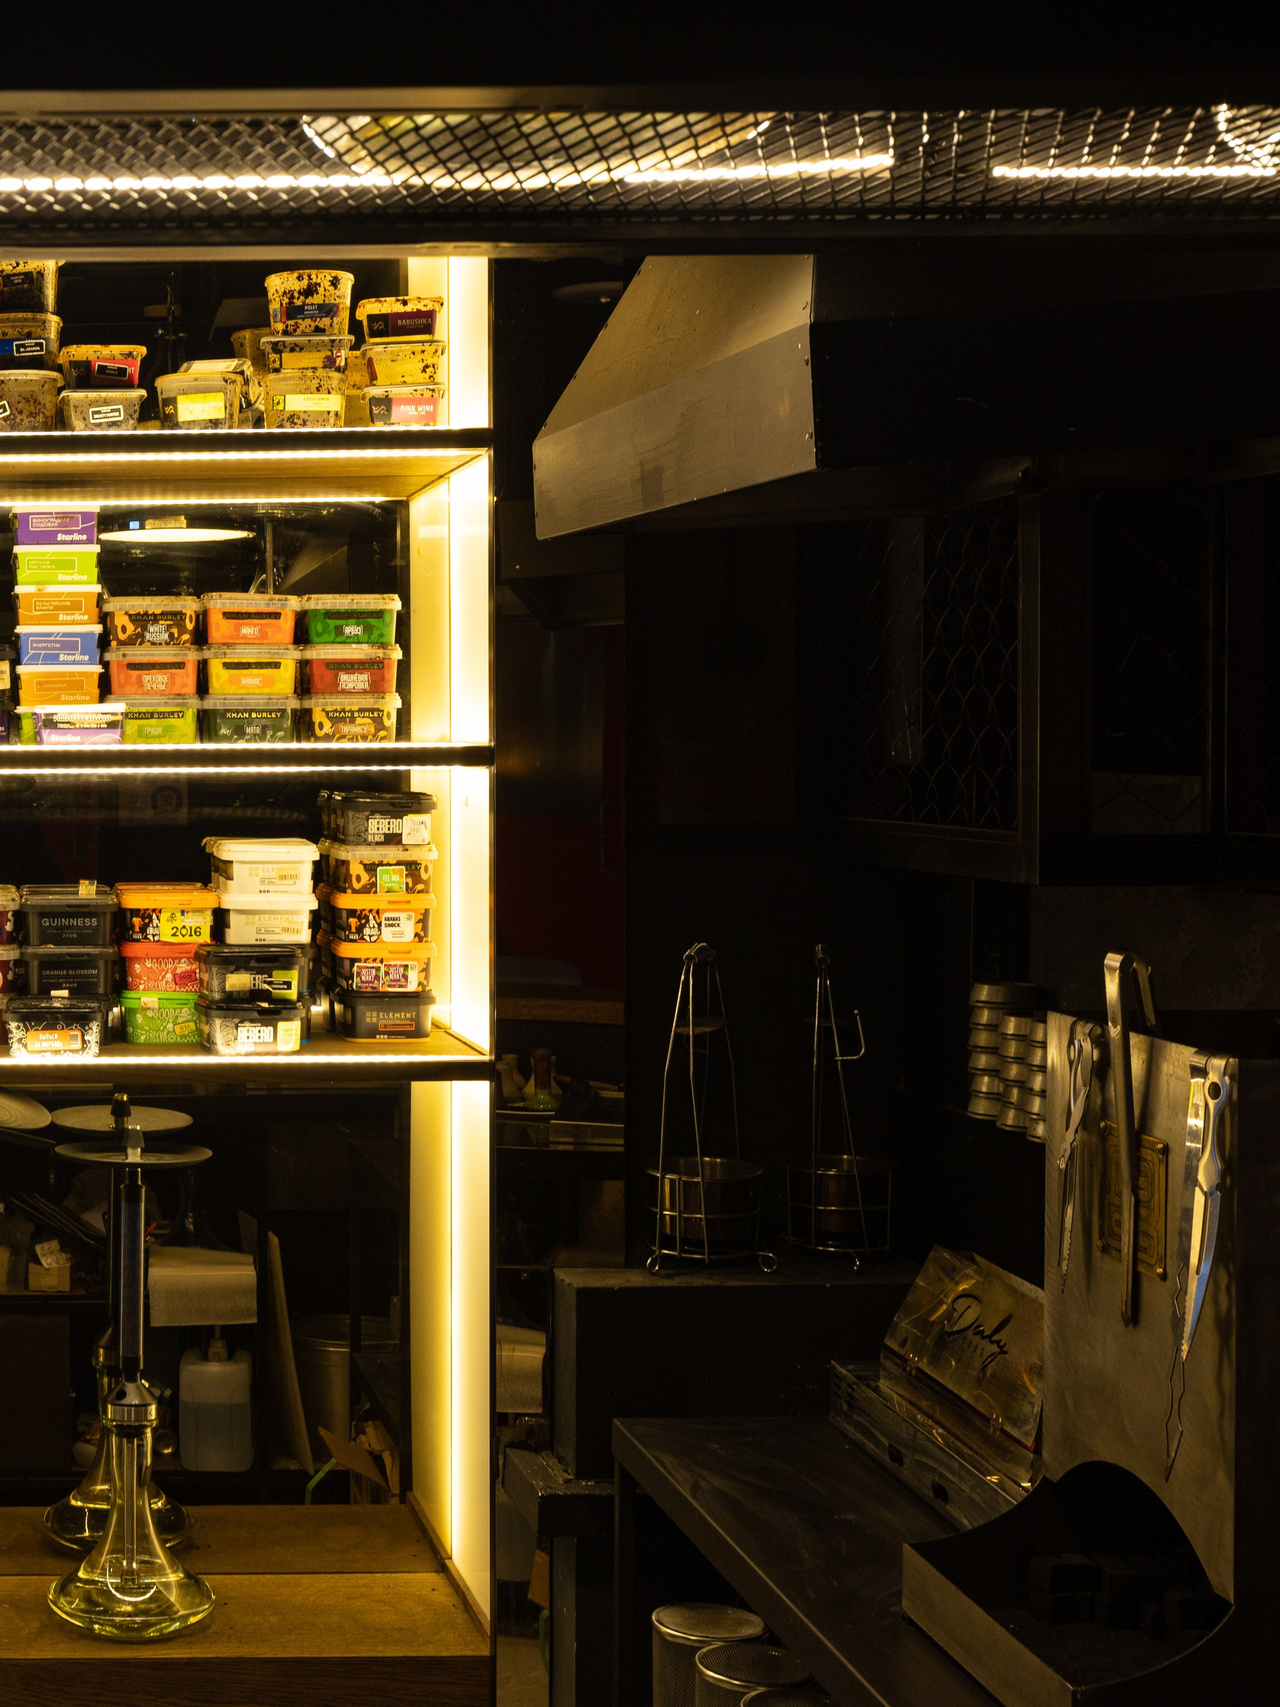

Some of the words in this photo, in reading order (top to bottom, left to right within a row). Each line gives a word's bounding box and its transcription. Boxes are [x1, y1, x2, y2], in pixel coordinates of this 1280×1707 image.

[398, 318, 432, 326] BABUSHKA
[149, 624, 166, 632] WHITE
[145, 632, 169, 640] RUSSIAN
[144, 682, 166, 690] ПЕЧЕНЬЕ
[339, 681, 368, 689] ГАЗИРОВКА
[369, 819, 402, 834] SEBERO
[42, 918, 98, 926] GUINNESS
[171, 925, 202, 938] 2016
[238, 1026, 273, 1042] SEBERO
